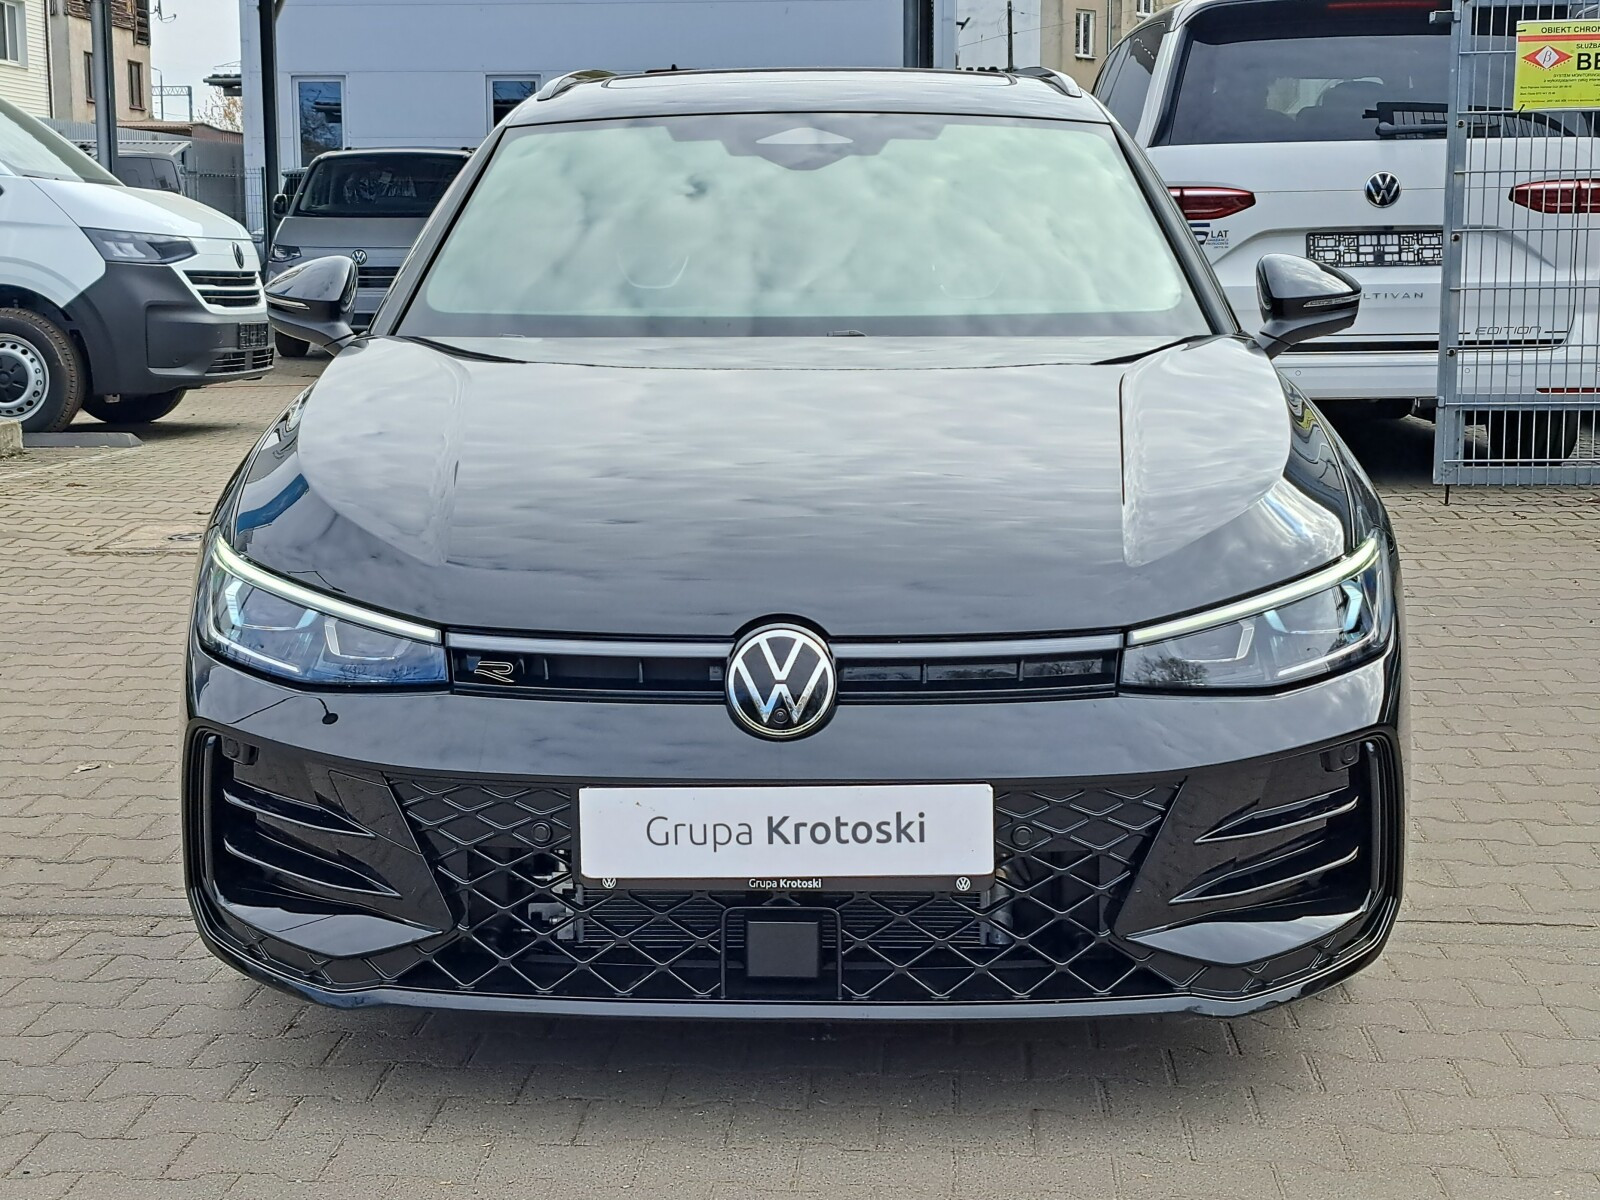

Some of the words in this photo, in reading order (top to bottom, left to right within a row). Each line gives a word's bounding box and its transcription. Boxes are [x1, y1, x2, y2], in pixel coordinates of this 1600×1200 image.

[1541, 26, 1571, 34] OBIEKT
[1365, 172, 1401, 207] VW
[1211, 230, 1229, 238] LAT
[1363, 292, 1424, 300] LTIVAN
[1475, 326, 1542, 335] EDITION
[731, 625, 832, 729] VW
[646, 815, 753, 853] Grupa
[767, 811, 925, 845] Krotoski
[748, 878, 778, 890] Grupa
[780, 878, 822, 889] Krotoski
